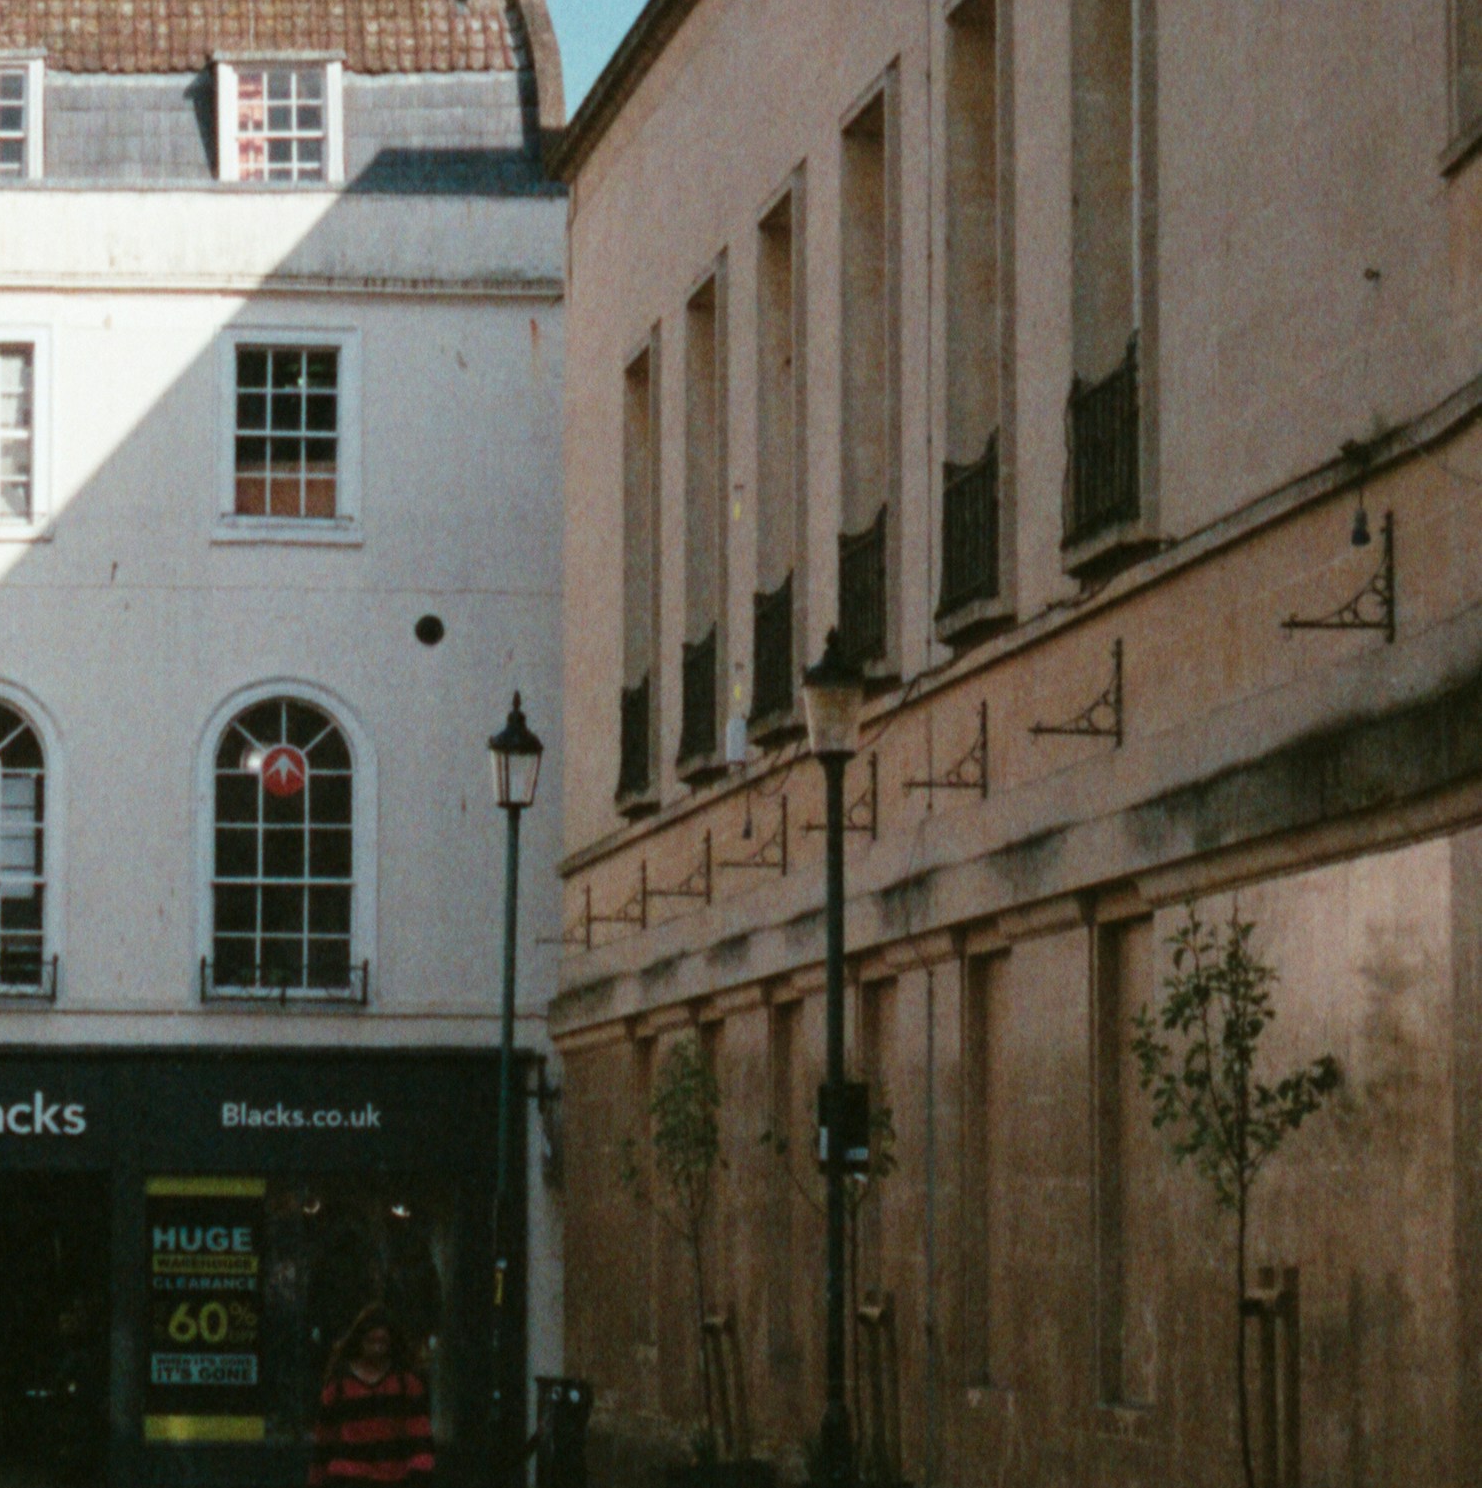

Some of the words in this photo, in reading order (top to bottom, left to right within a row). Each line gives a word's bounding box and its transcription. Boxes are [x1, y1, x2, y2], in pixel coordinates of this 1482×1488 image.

[221, 1101, 382, 1127] Blacks.co.uk
[152, 1226, 253, 1252] HUGE
[152, 1276, 257, 1290] CLEARANCE
[198, 1368, 251, 1381] GONE
